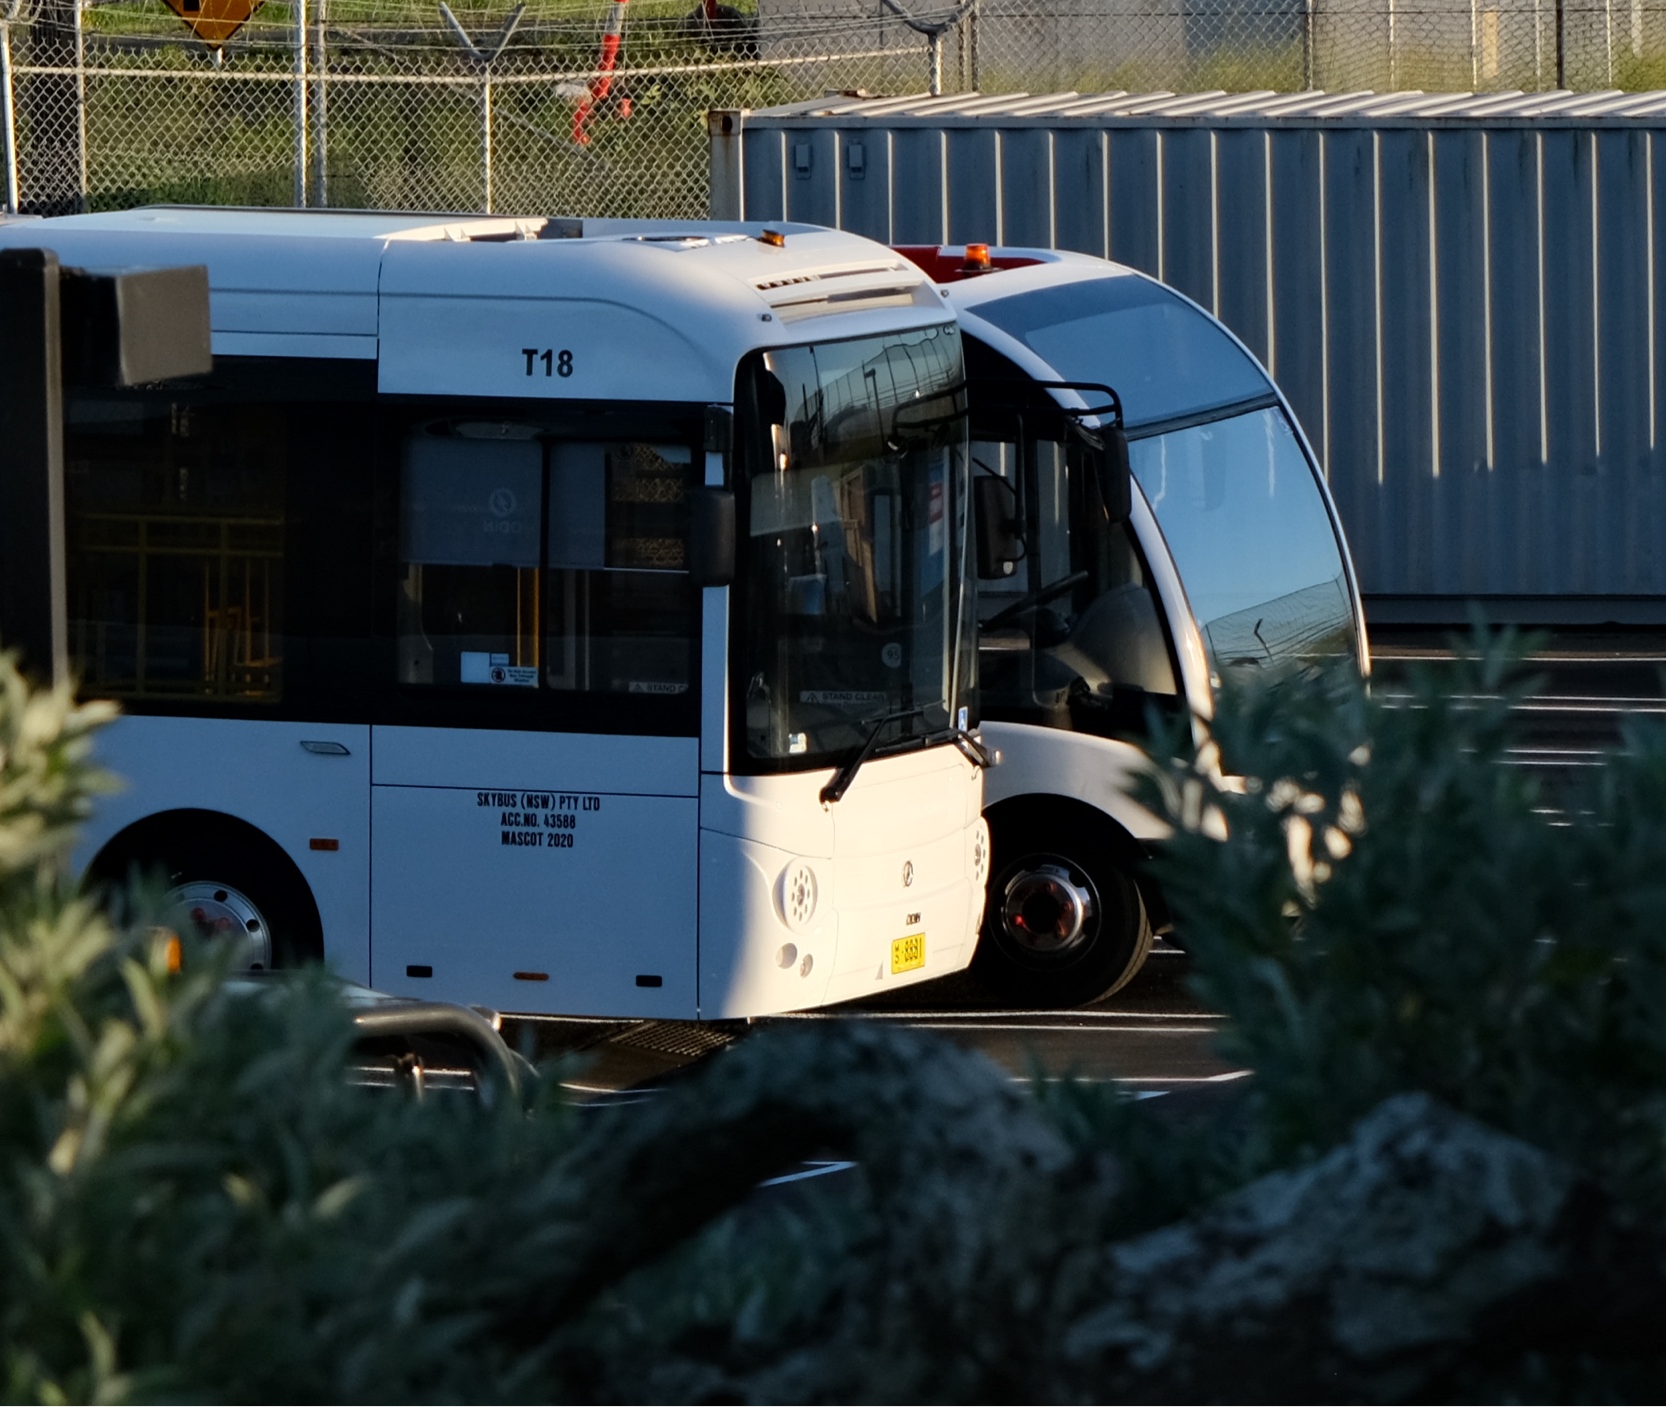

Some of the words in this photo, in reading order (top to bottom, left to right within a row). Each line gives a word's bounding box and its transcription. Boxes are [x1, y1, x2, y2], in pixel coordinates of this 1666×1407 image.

[521, 348, 573, 378] T18
[822, 692, 853, 701] STAND
[477, 792, 517, 808] SKYBUS
[520, 793, 556, 811] (NSW)
[559, 795, 579, 811] PTY
[582, 796, 600, 811] LTD
[544, 814, 576, 829] 43588
[501, 831, 544, 846] MASCOT
[547, 832, 574, 848] 2020
